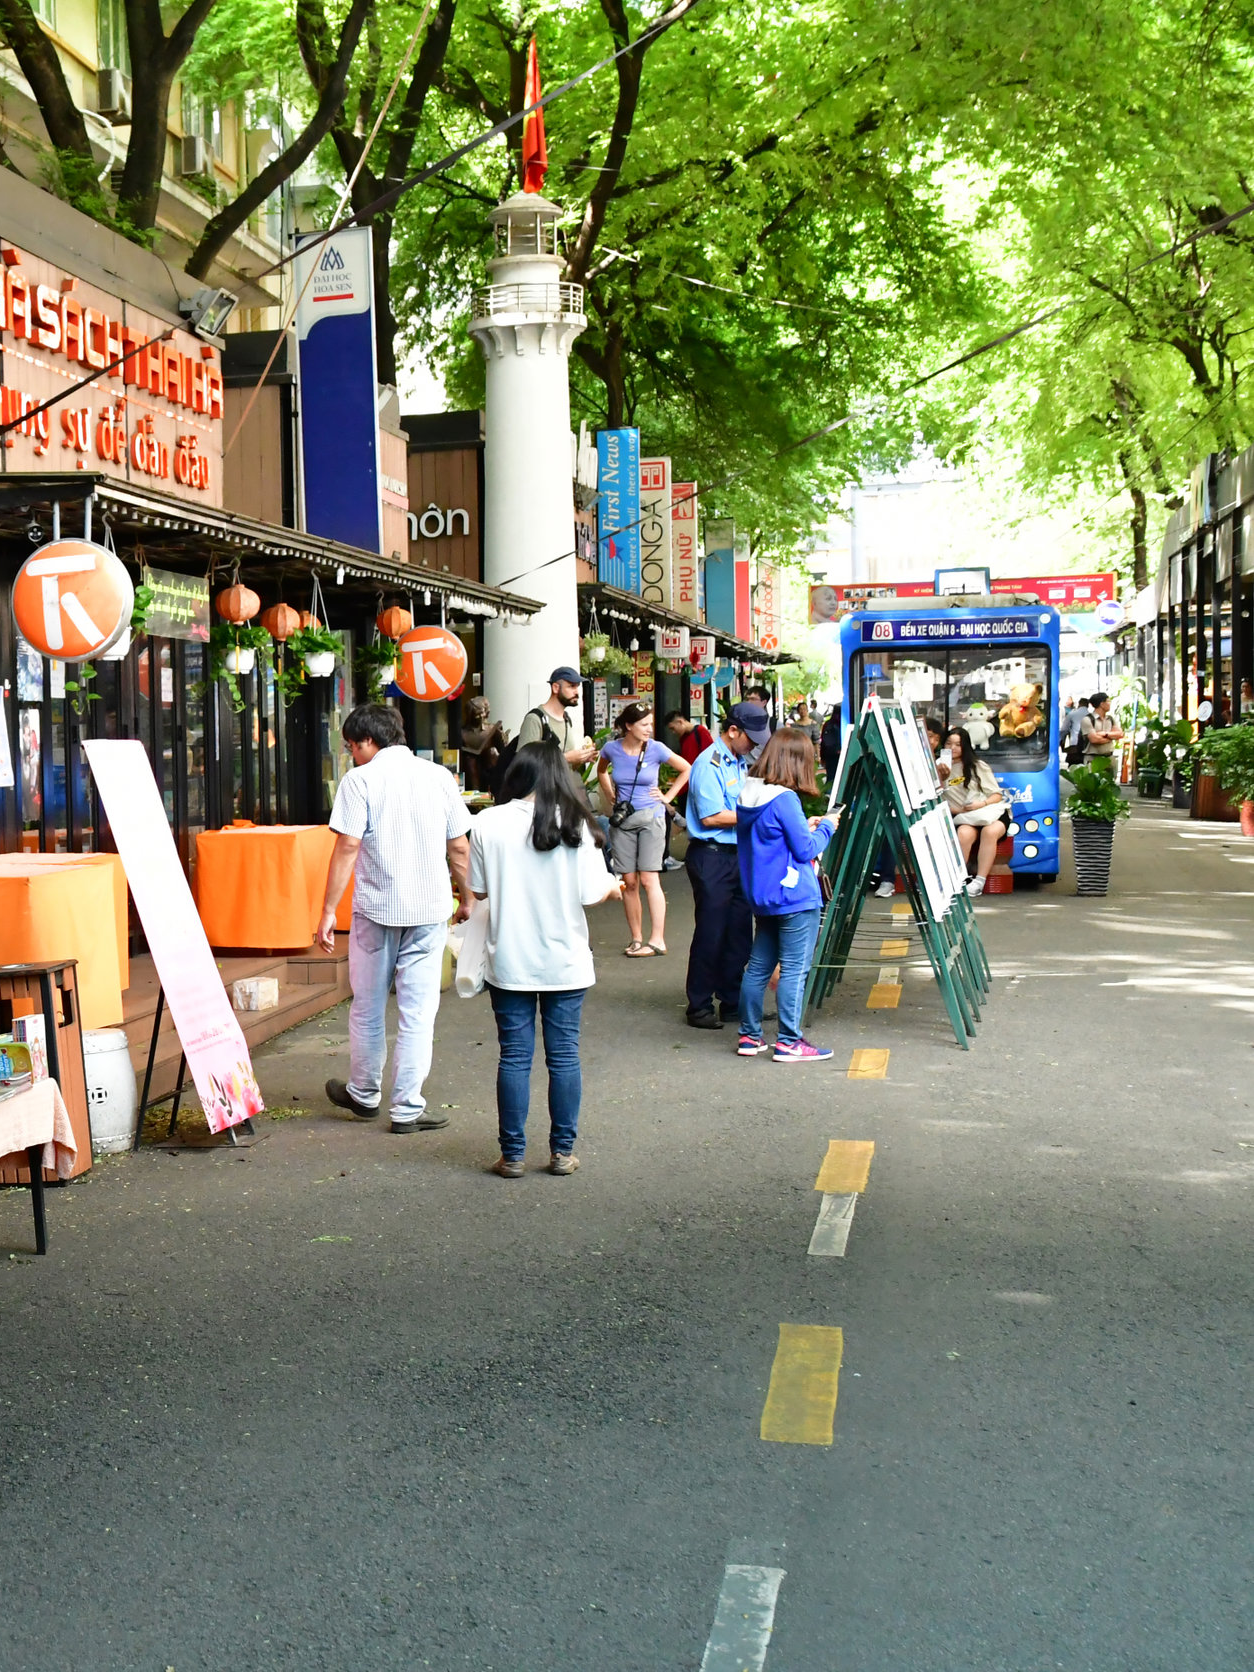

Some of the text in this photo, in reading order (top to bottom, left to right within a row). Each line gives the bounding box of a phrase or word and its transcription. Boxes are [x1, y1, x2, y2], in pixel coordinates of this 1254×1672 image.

[27, 277, 125, 378] SÁCH
[601, 434, 621, 533] First News
[627, 570, 638, 595] here
[680, 565, 696, 603] PHỤ
[874, 624, 891, 638] 08
[900, 621, 917, 637] BẾN
[917, 625, 928, 636] XE
[928, 621, 950, 638] QUẬN
[950, 624, 956, 636] 8
[960, 623, 974, 638] ĐẠI
[974, 622, 992, 637] HỌC
[992, 617, 1014, 635] QUỐC
[1014, 621, 1029, 634] GIA
